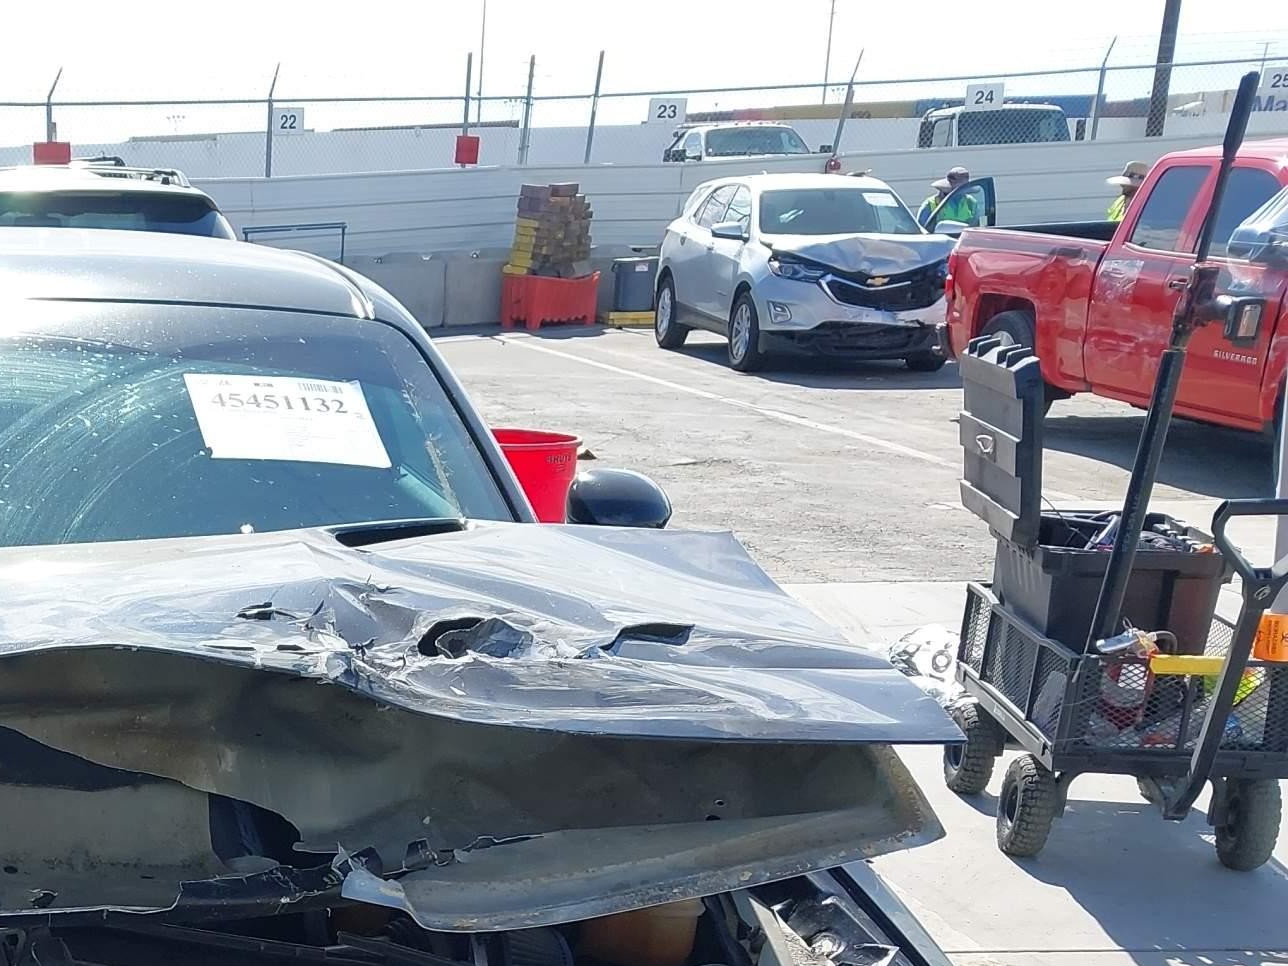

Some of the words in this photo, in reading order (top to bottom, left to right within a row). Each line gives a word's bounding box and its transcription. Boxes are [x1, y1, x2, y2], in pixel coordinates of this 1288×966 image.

[974, 90, 994, 105] 24
[656, 104, 677, 119] 23
[280, 114, 297, 130] 22
[1213, 349, 1258, 365] SILVERADO
[211, 392, 348, 414] 45451132
